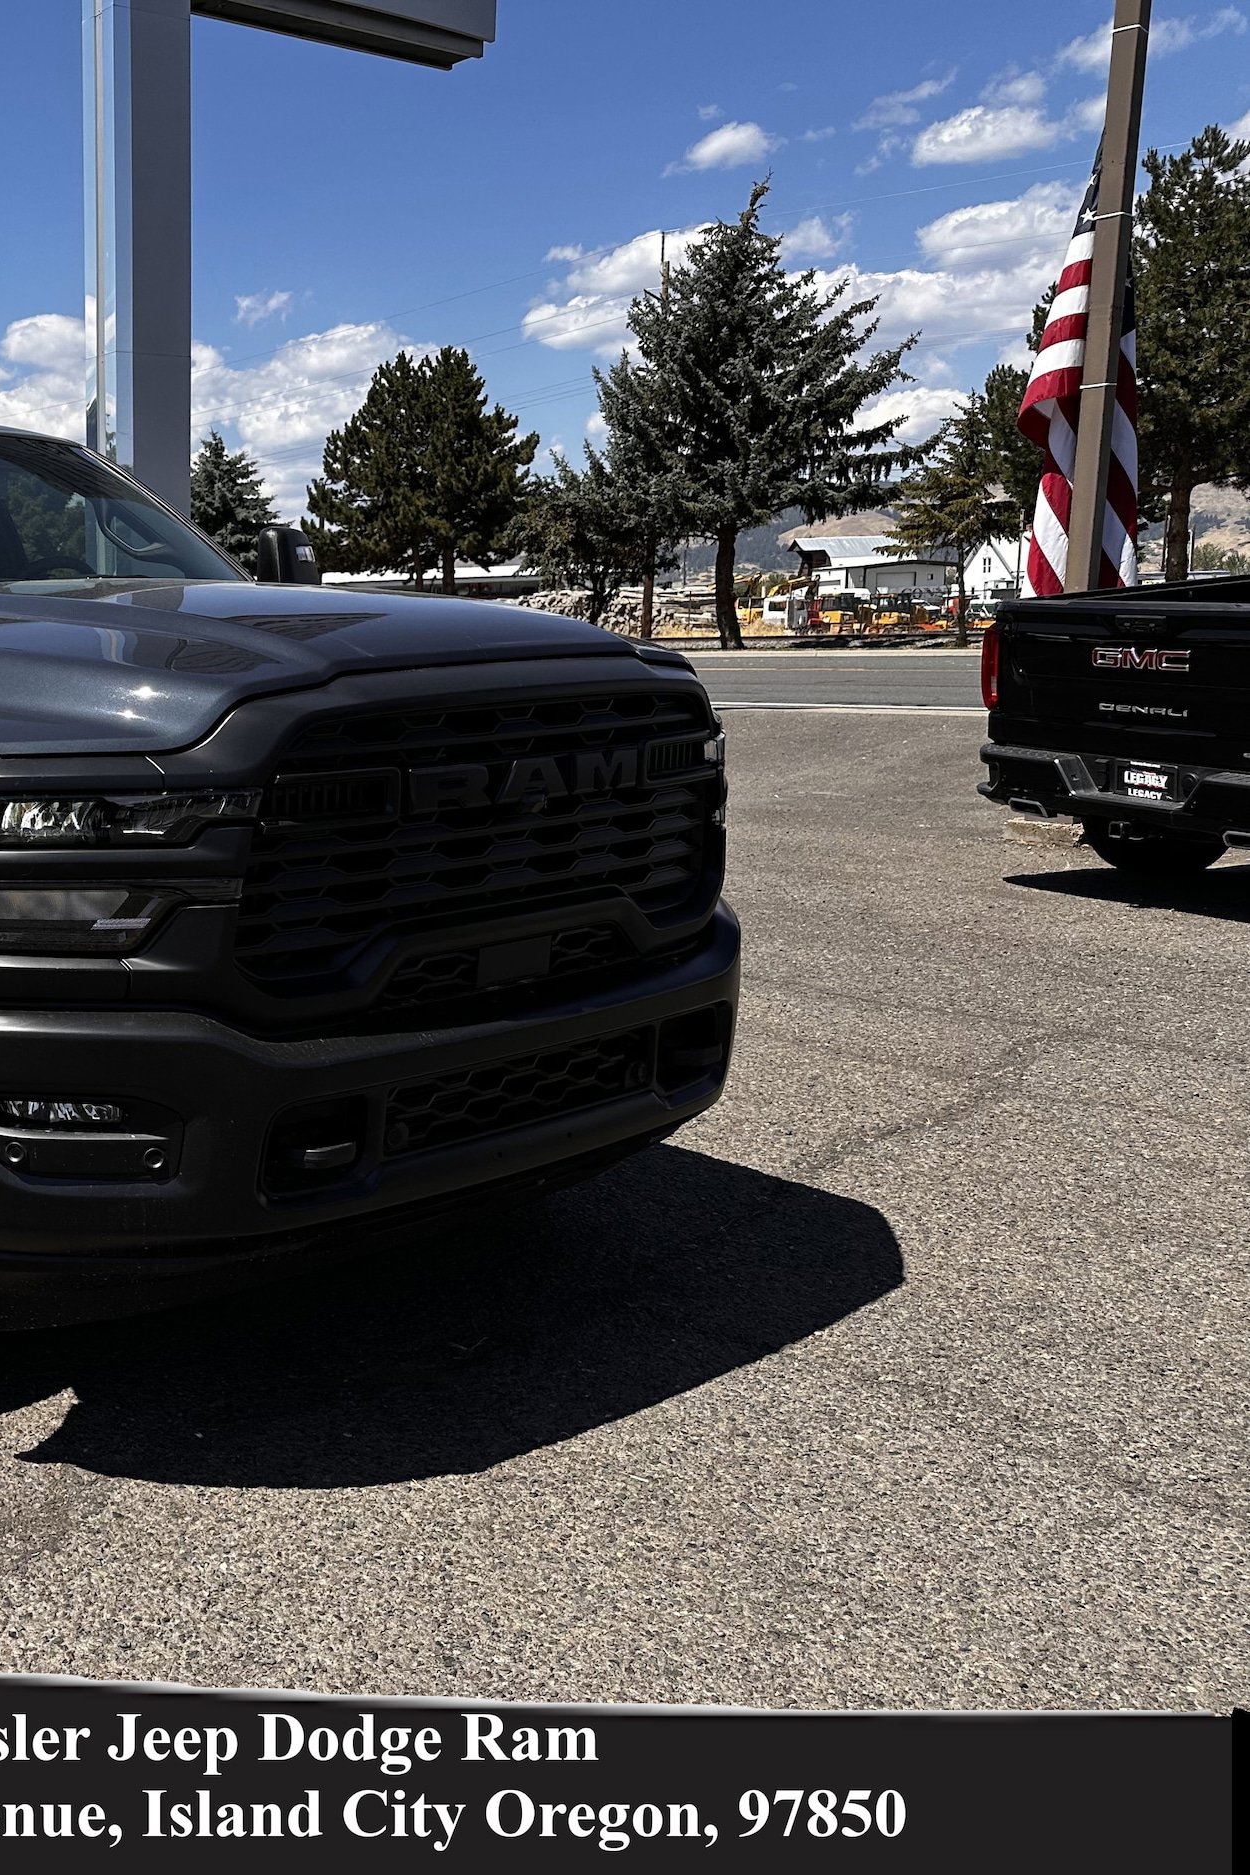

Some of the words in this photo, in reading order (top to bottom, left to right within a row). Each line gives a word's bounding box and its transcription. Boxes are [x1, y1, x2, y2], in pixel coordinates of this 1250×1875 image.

[1092, 647, 1191, 672] GMC
[1099, 702, 1188, 718] DENALI
[408, 744, 638, 815] RAM
[1124, 770, 1168, 788] LEGACY
[1128, 787, 1162, 800] LEGACY
